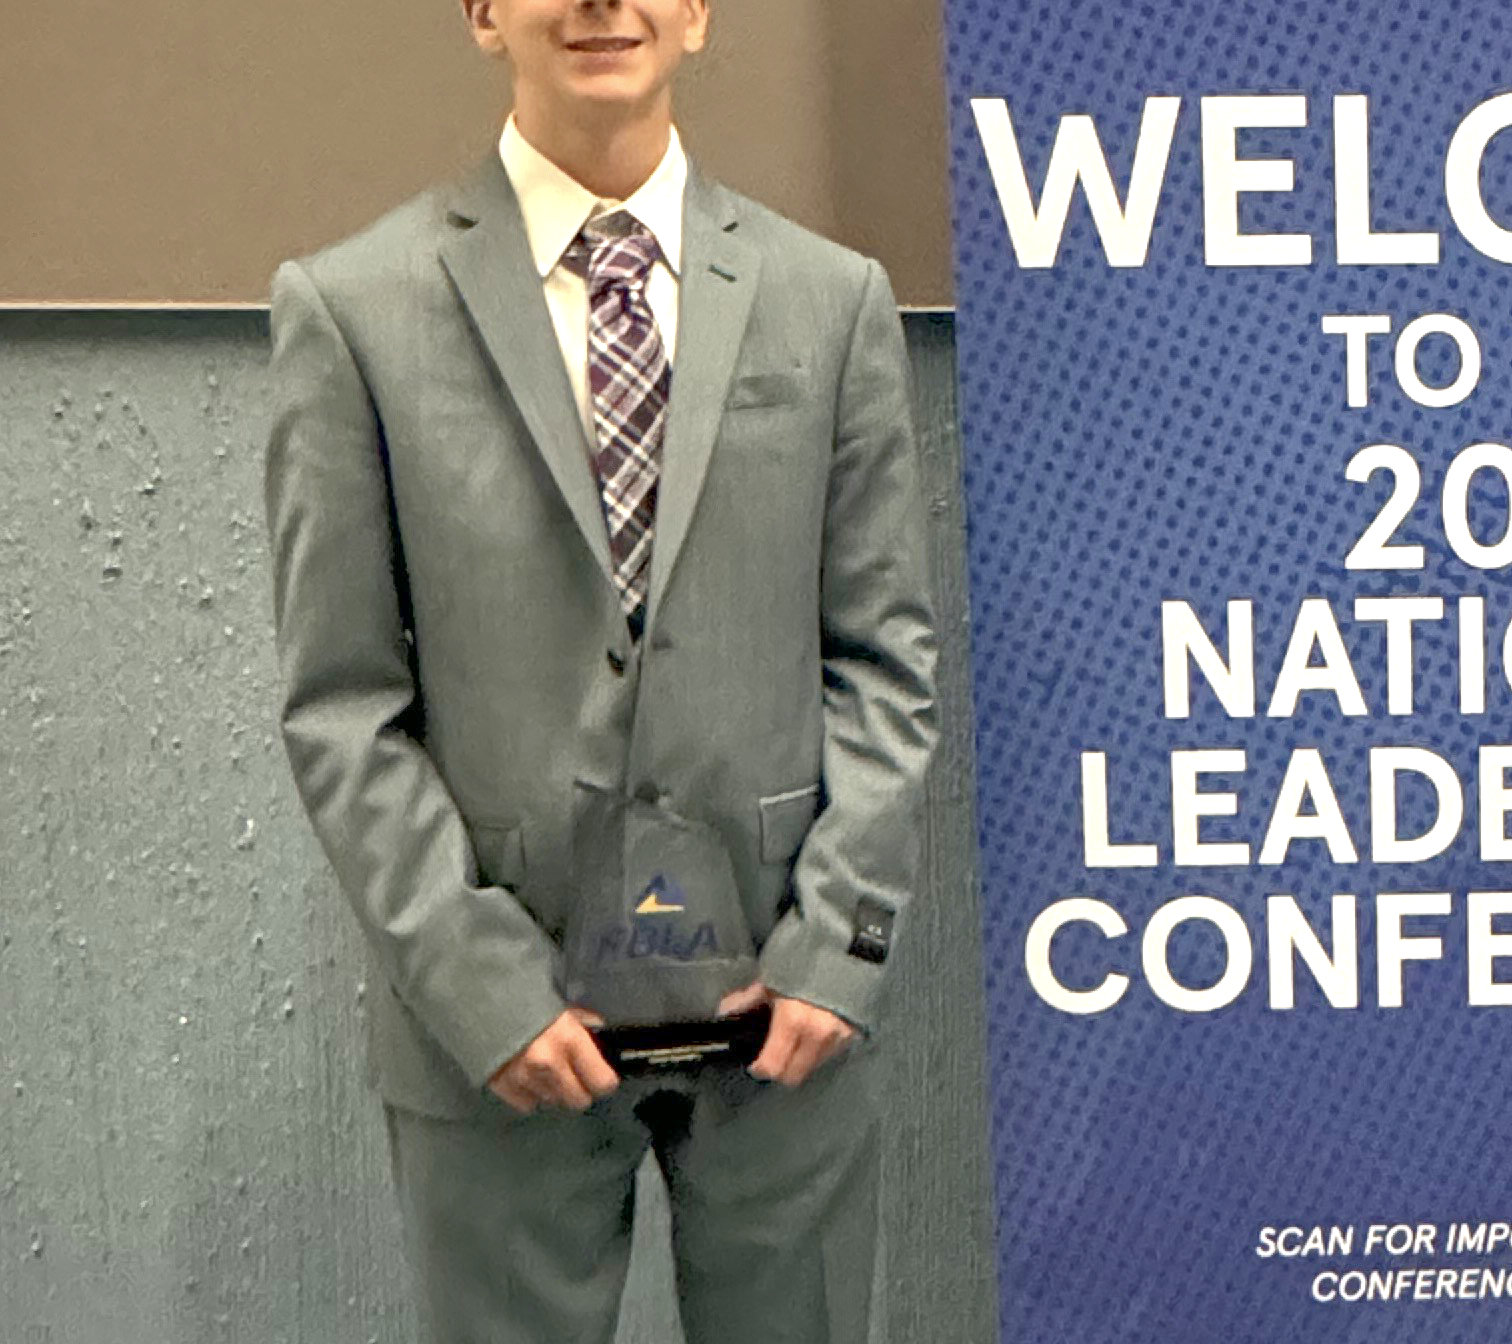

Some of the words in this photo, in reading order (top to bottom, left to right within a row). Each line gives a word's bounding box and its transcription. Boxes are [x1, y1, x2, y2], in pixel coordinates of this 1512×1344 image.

[1321, 312, 1482, 408] TO
[1255, 1224, 1354, 1258] SCAN
[1364, 1224, 1437, 1256] FOR
